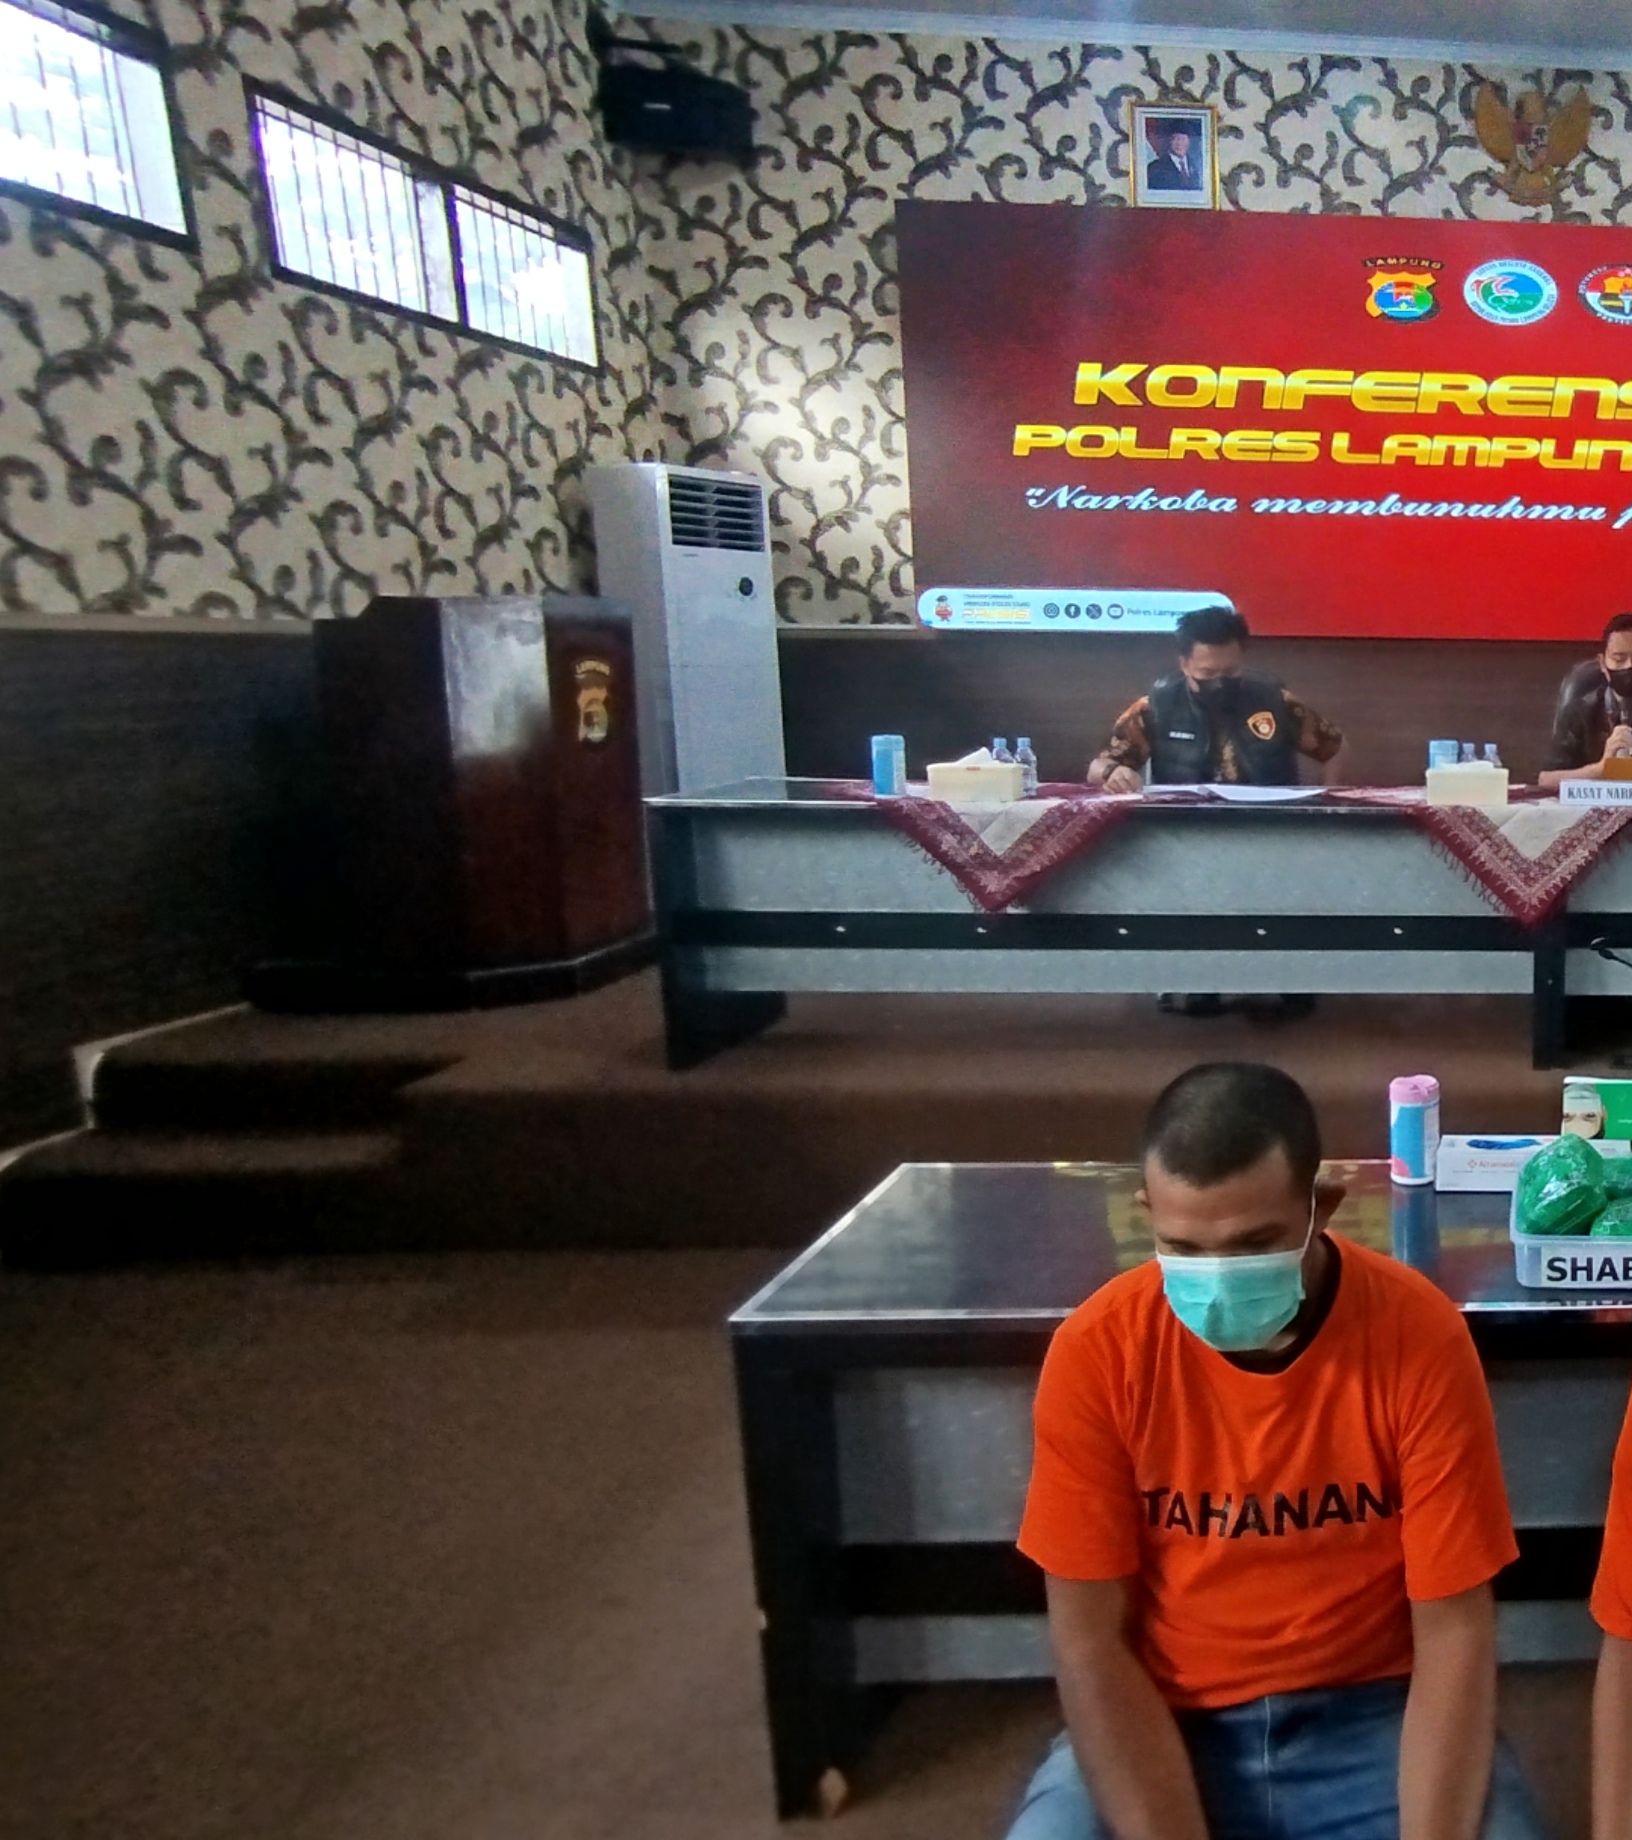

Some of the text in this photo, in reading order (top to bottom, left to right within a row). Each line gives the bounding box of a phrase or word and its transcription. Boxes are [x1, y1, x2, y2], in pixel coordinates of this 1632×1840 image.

[1364, 257, 1443, 270] LAMPUNG
[1012, 423, 1321, 462] POLRES
[1250, 493, 1607, 521] membunuhmu
[1567, 787, 1602, 799] KASAT
[1141, 1482, 1400, 1538] TAHANAN
